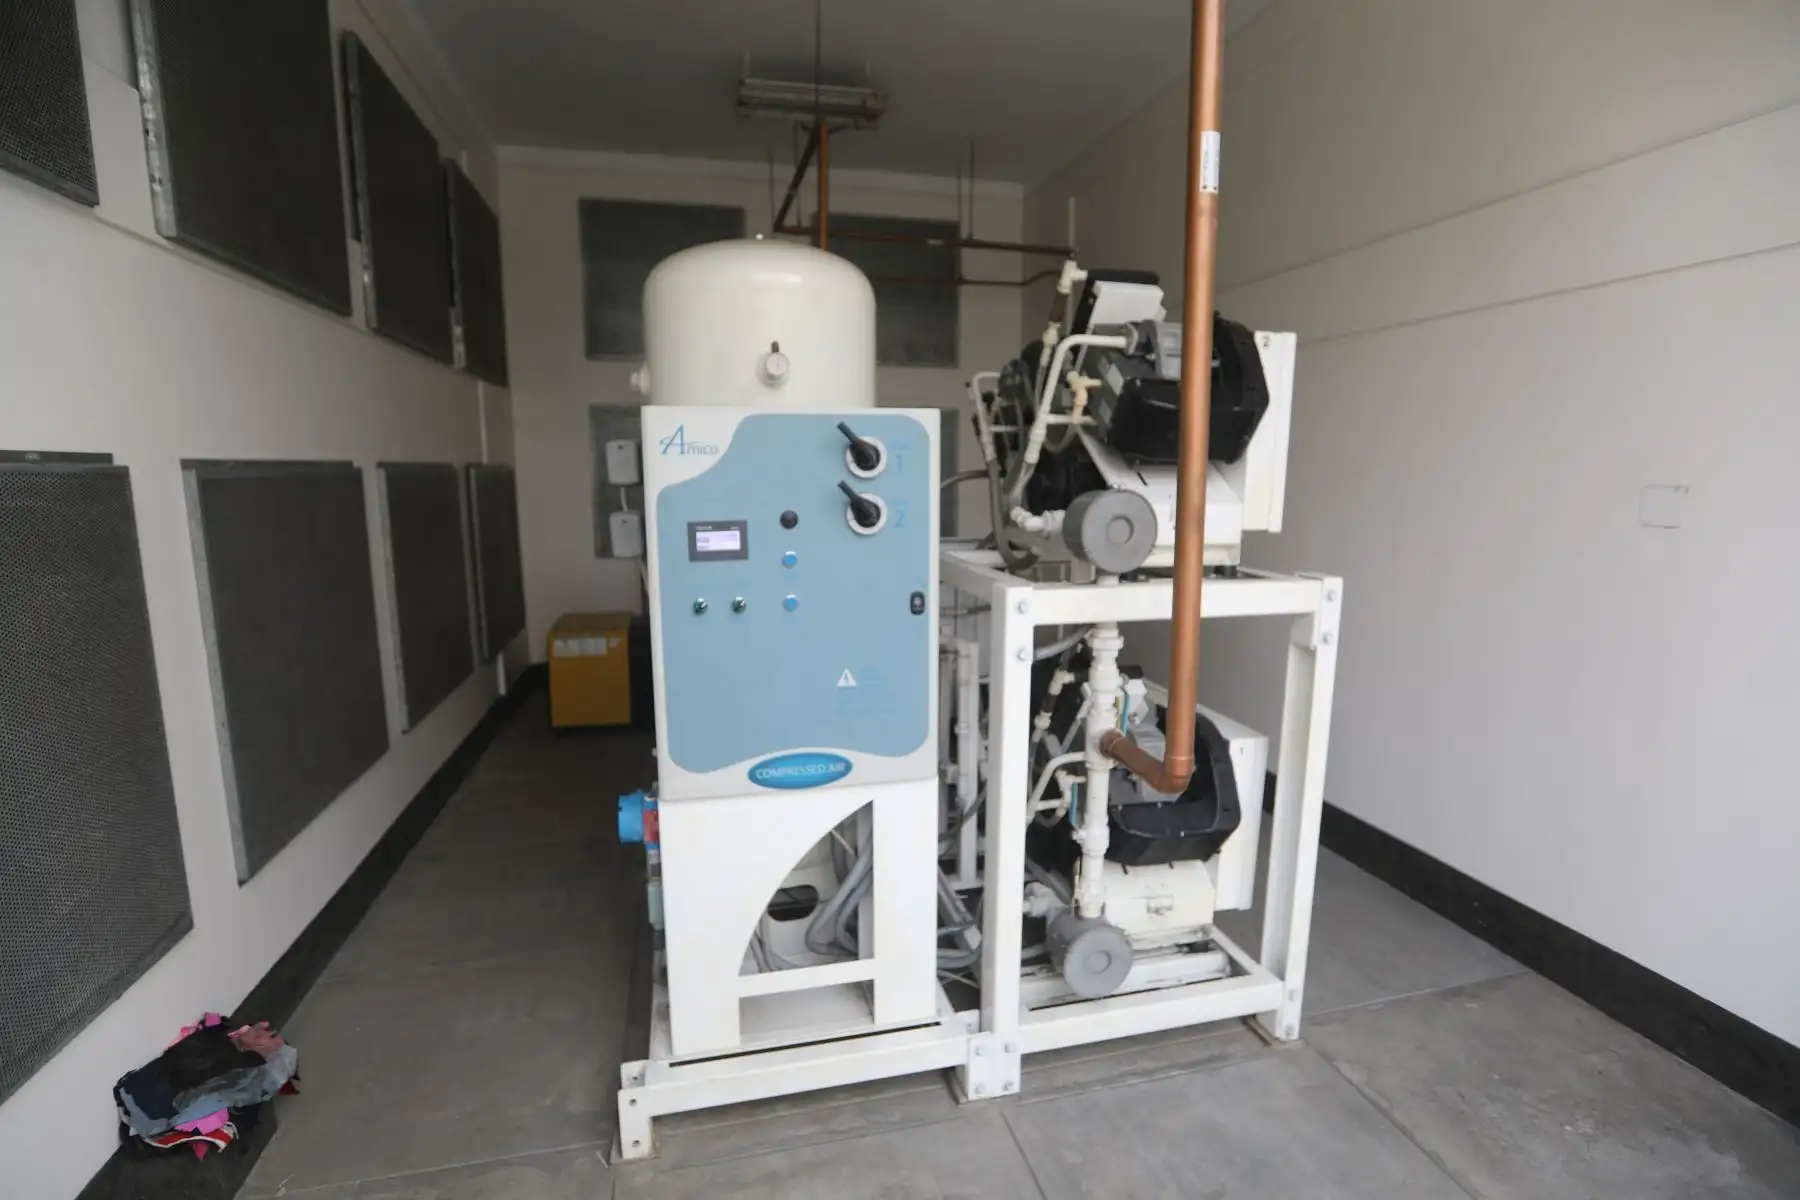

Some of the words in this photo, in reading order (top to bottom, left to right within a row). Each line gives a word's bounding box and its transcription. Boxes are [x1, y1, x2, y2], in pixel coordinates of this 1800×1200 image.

[893, 453, 903, 473] 1
[894, 508, 906, 528] 2
[756, 764, 826, 779] COMPRESSED
[827, 762, 846, 773] AIR
